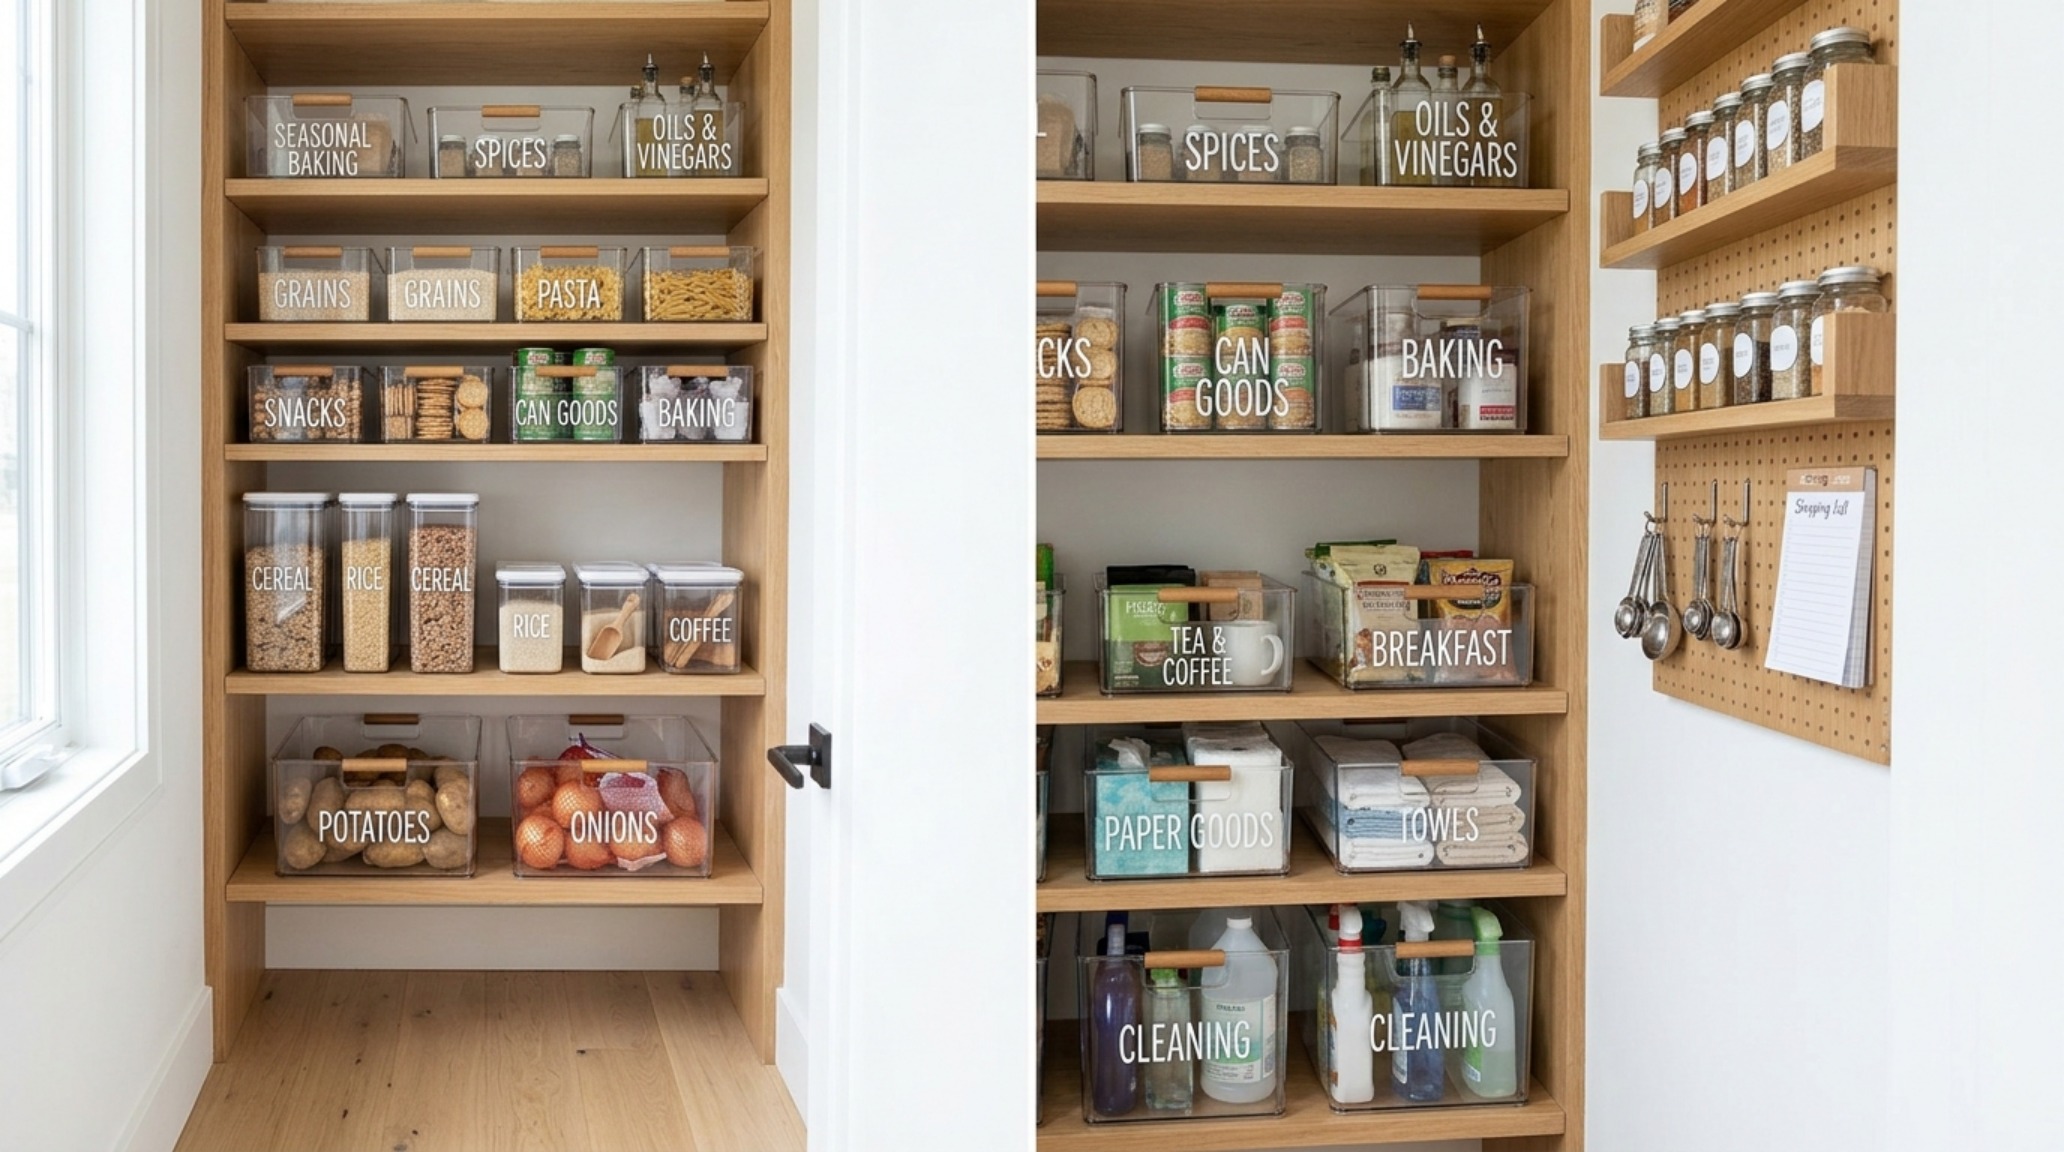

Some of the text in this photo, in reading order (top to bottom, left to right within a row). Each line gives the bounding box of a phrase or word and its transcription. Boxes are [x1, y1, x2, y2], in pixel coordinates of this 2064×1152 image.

[274, 121, 373, 149] SEASONAL
[652, 113, 717, 142] OILS &
[1415, 100, 1499, 138] OILS &
[287, 150, 360, 177] BAKING
[474, 137, 547, 170] SPICES
[637, 142, 733, 171] VINEGARS
[1185, 131, 1280, 173] SPICES
[1394, 140, 1519, 179] VINEGARS
[273, 279, 352, 310] GRAINS
[404, 279, 482, 310] GRAINS
[537, 279, 603, 310] PASTA
[1214, 336, 1270, 376] CAN
[1402, 338, 1504, 380] BAKING
[264, 397, 347, 429] SNACKS
[515, 398, 619, 427] CAN GOODS
[658, 397, 737, 429] BAKING
[1195, 379, 1290, 419] GOODS
[252, 566, 314, 592] CEREAL
[346, 566, 385, 591] RICE
[411, 566, 472, 592] CEREAL
[512, 613, 551, 640] RICE
[669, 616, 733, 644] COFFEE
[1170, 626, 1227, 655] TEA &
[1372, 629, 1513, 668] BREAKFAST
[1163, 657, 1234, 687] COFFEE
[317, 809, 431, 844] POTATOES
[570, 809, 659, 844] ONIONS
[1104, 812, 1275, 852] PAPER GOODS
[1400, 806, 1480, 843] TOWES
[1118, 1020, 1251, 1065] CLEANING
[1369, 1009, 1498, 1053] CLEANING
